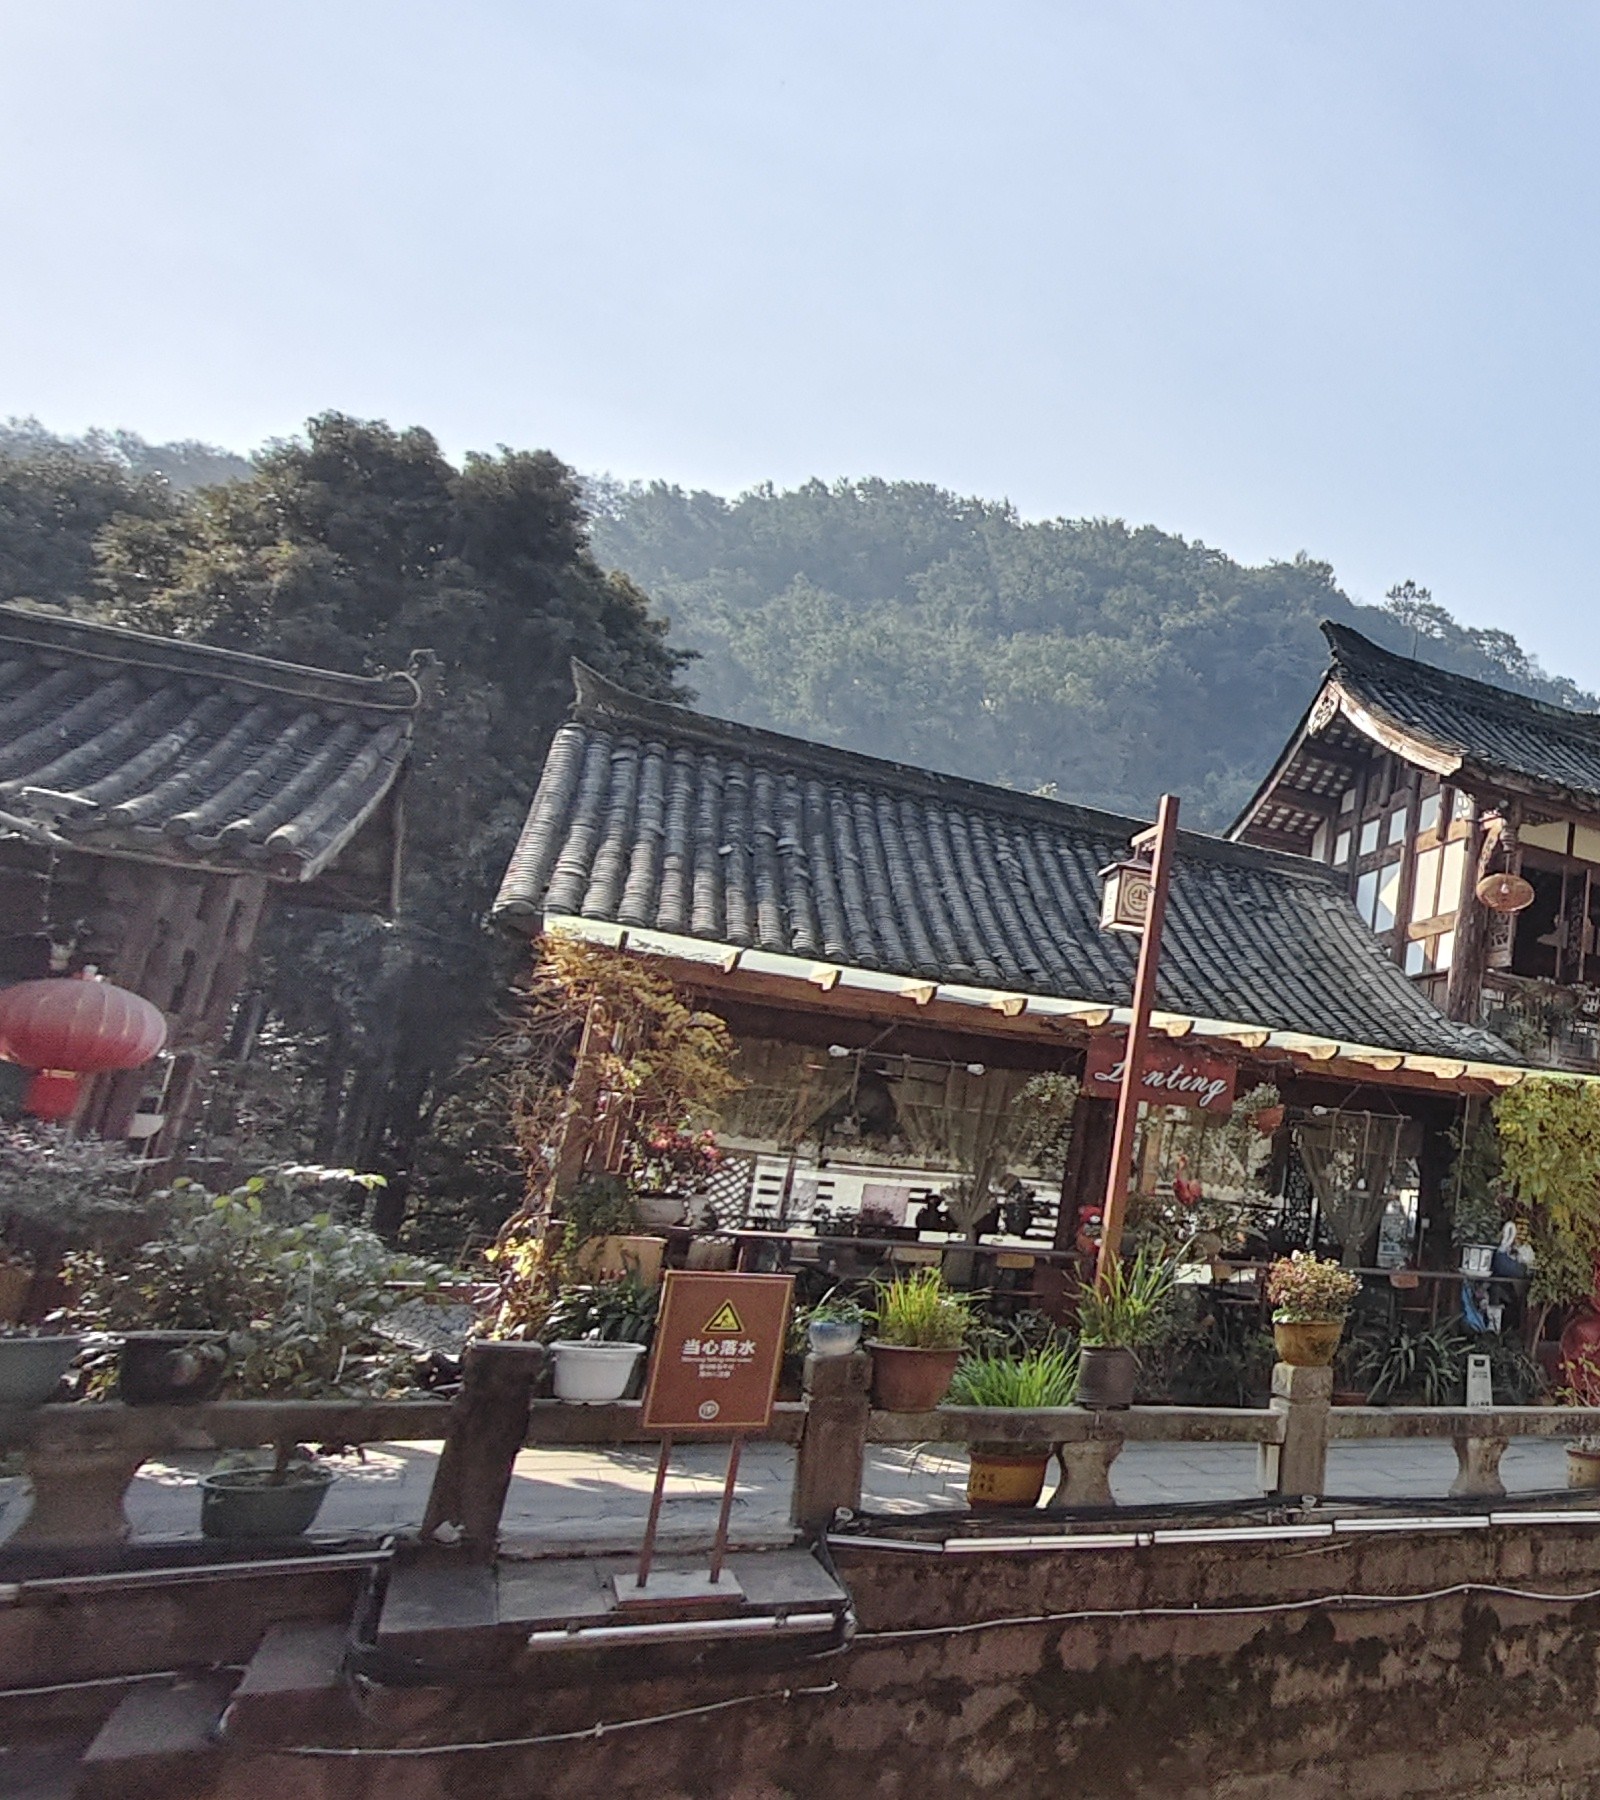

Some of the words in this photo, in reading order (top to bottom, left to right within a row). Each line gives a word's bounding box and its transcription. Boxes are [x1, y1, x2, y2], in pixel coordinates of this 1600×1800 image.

[1094, 1062, 1227, 1107] Lnting
[682, 1338, 757, 1356] 当心落水
